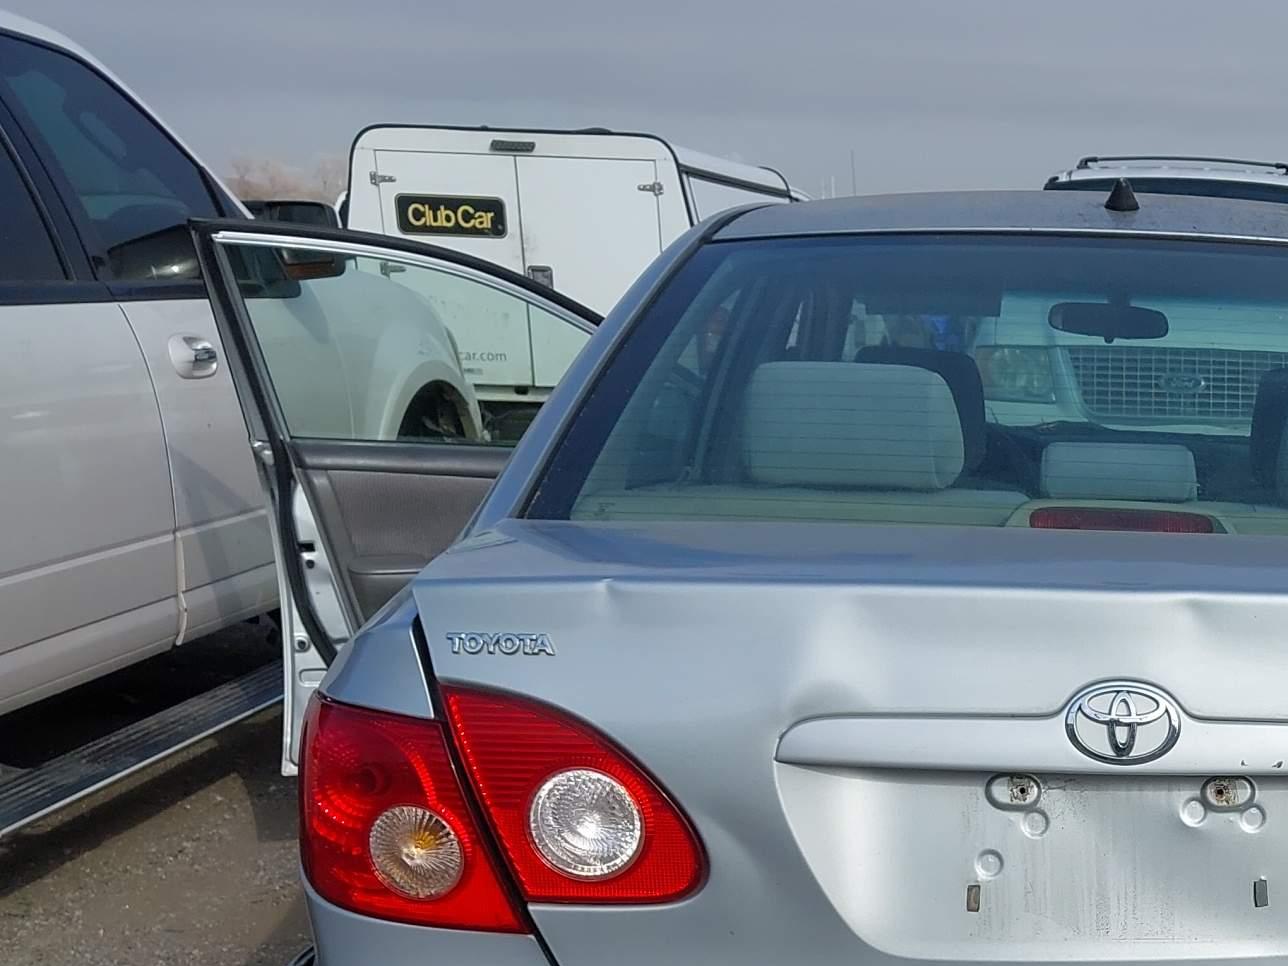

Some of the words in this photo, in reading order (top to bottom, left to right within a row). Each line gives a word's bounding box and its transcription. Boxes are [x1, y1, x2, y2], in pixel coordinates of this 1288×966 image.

[407, 203, 456, 227] Club
[457, 205, 495, 229] Car
[446, 631, 556, 656] TOYOTA
